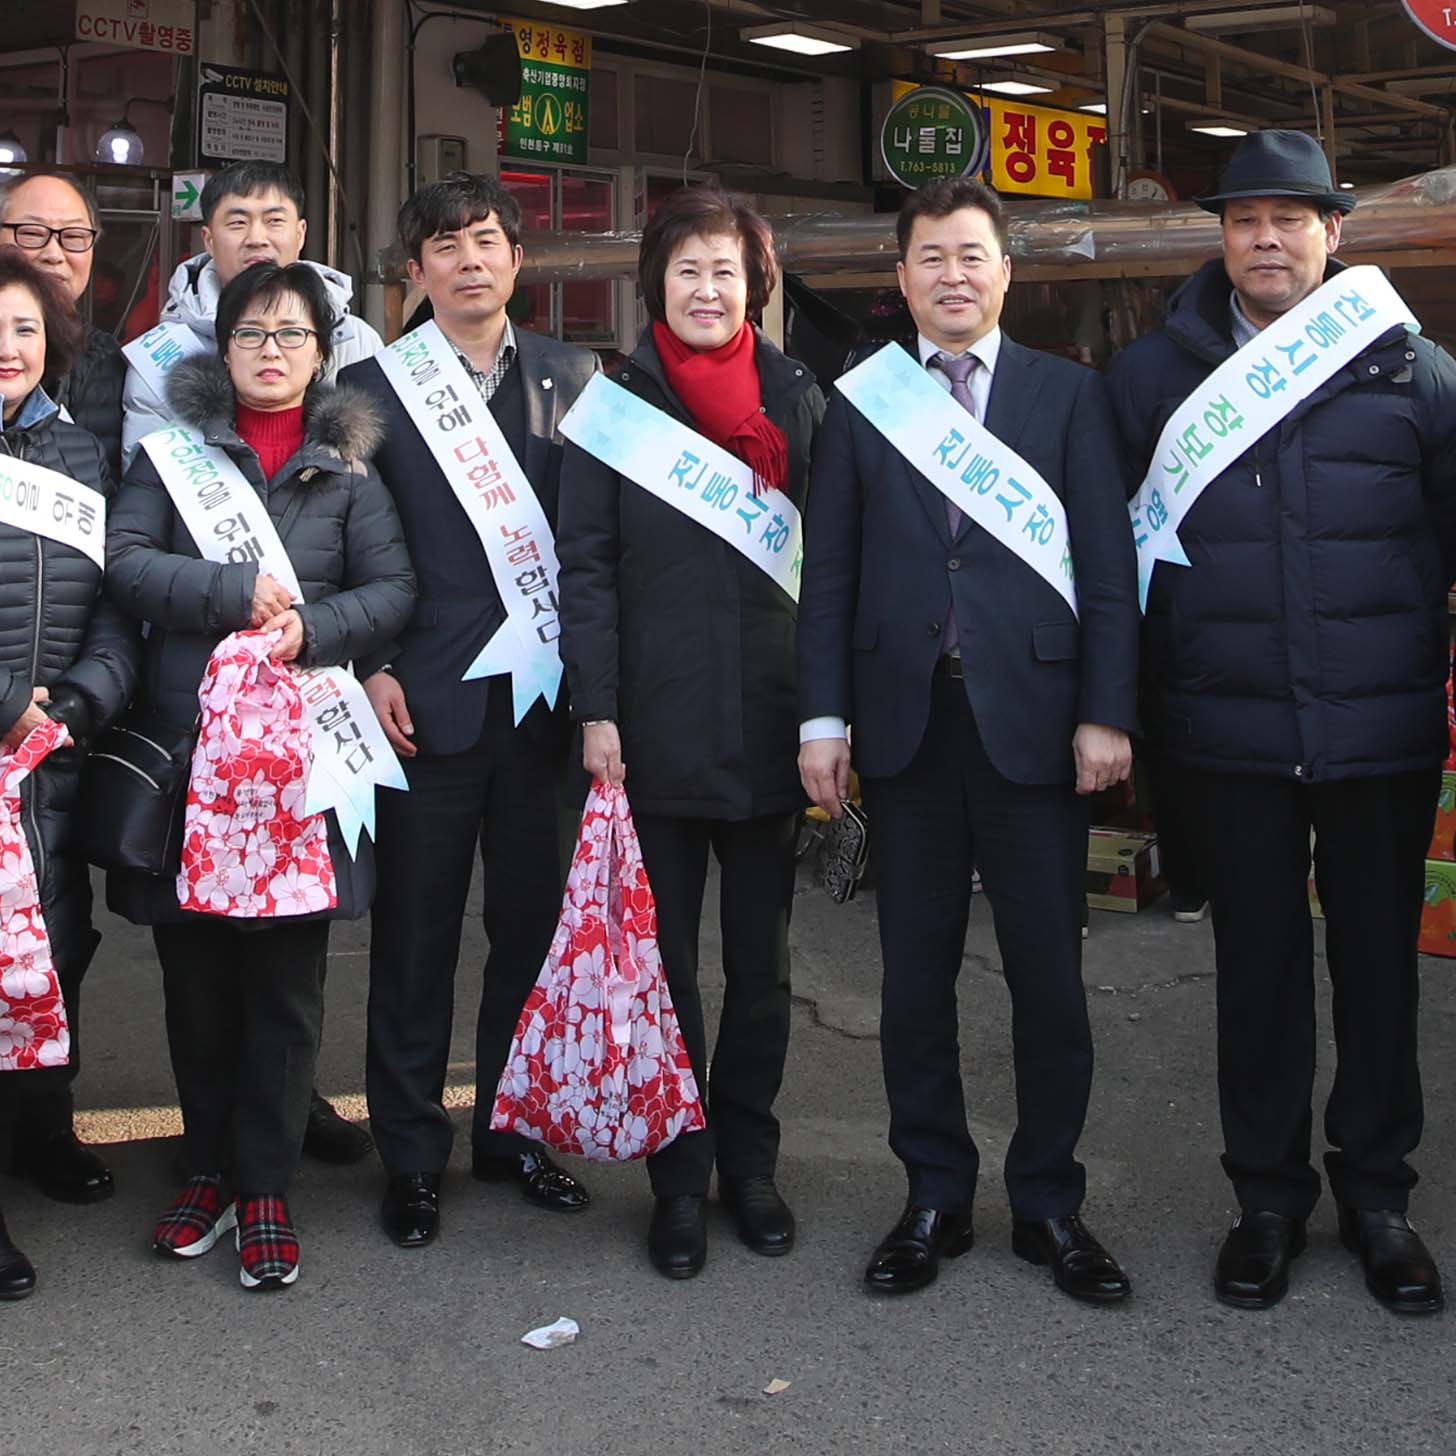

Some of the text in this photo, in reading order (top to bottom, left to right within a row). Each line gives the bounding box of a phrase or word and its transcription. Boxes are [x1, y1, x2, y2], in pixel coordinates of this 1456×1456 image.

[226, 74, 252, 90] CCTV
[497, 24, 585, 64] 영정육점
[894, 127, 963, 154] 나물집
[1246, 289, 1377, 399] 전통시장
[425, 384, 472, 432] 위해
[454, 436, 516, 510] 다함께
[1162, 394, 1244, 494] 장보기
[52, 491, 96, 536] 위해
[668, 451, 791, 554] 전통시장
[933, 428, 1056, 546] 전통시장
[213, 512, 264, 565] 위해
